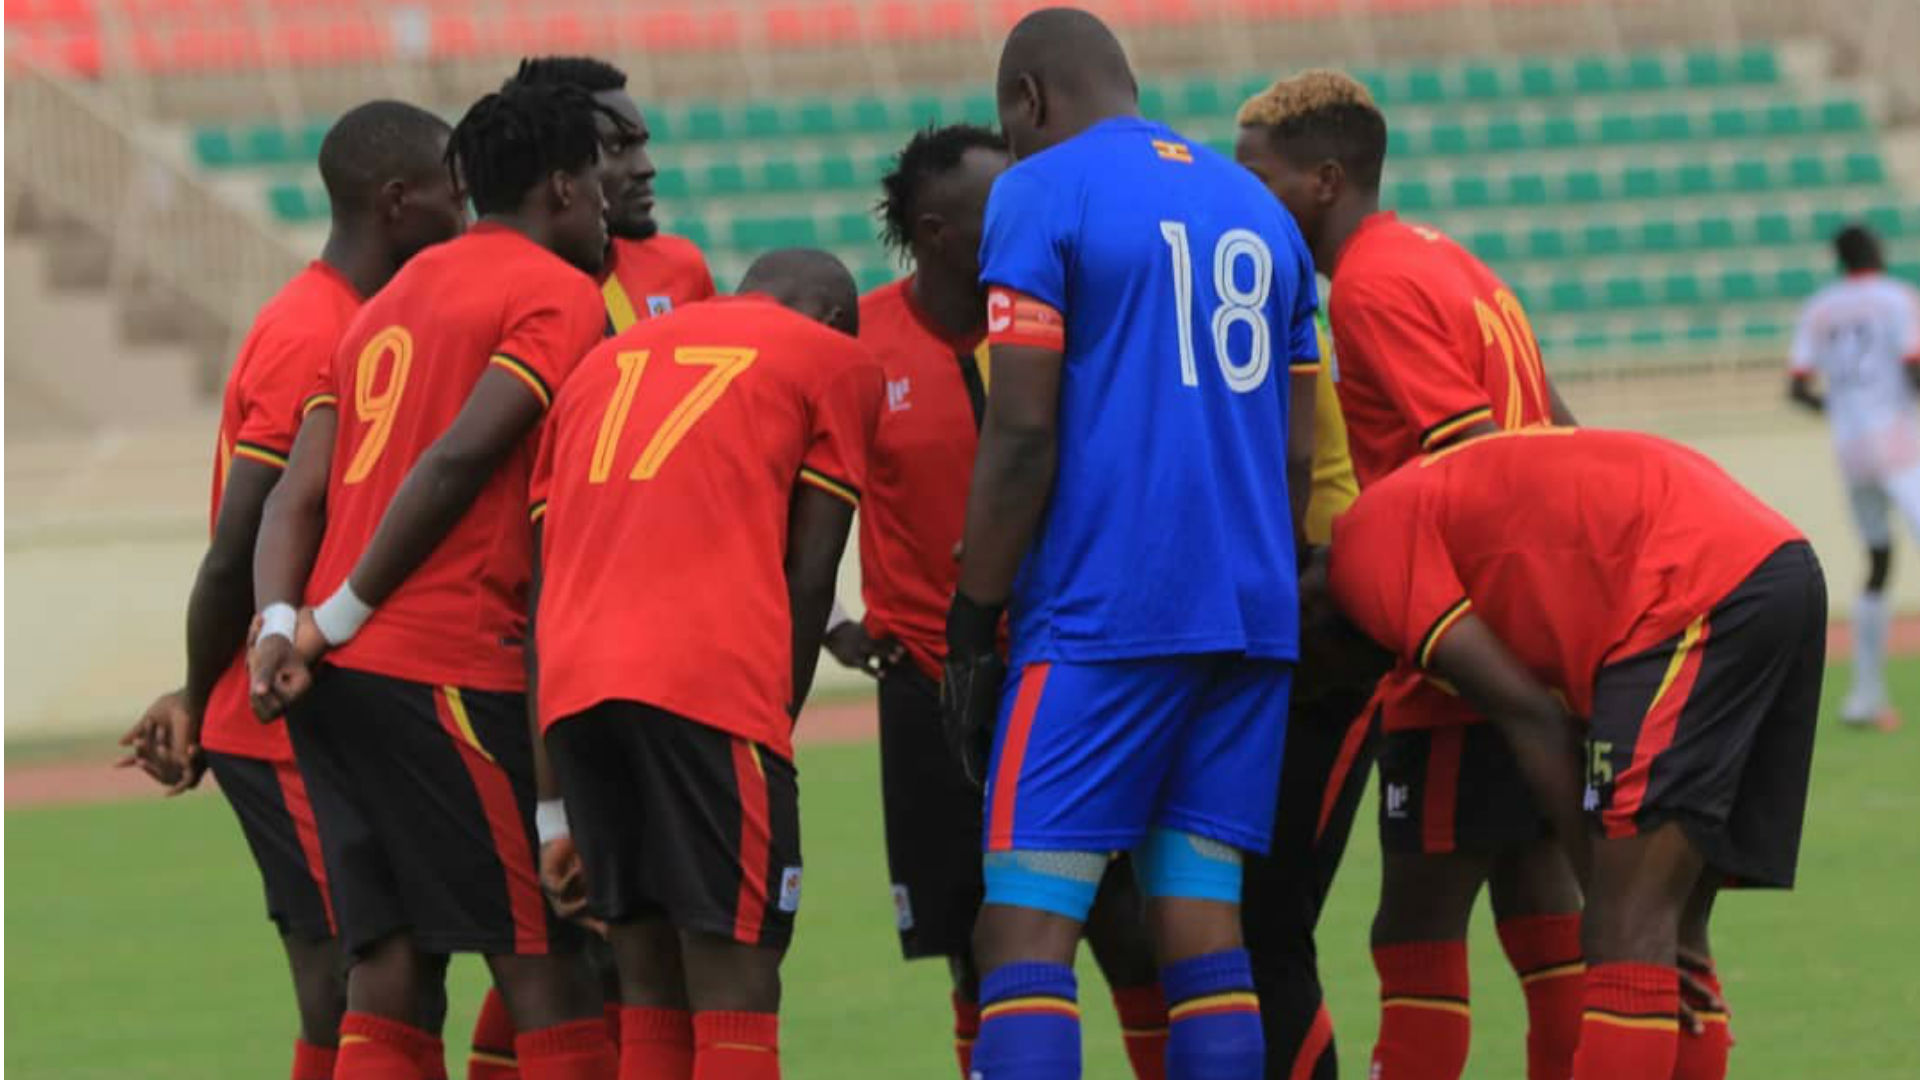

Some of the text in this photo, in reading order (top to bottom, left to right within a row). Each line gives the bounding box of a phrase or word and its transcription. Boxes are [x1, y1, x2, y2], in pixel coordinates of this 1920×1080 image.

[988, 292, 1011, 333] C
[1159, 221, 1272, 393] 18
[344, 325, 413, 484] 9
[589, 346, 758, 484] 17
